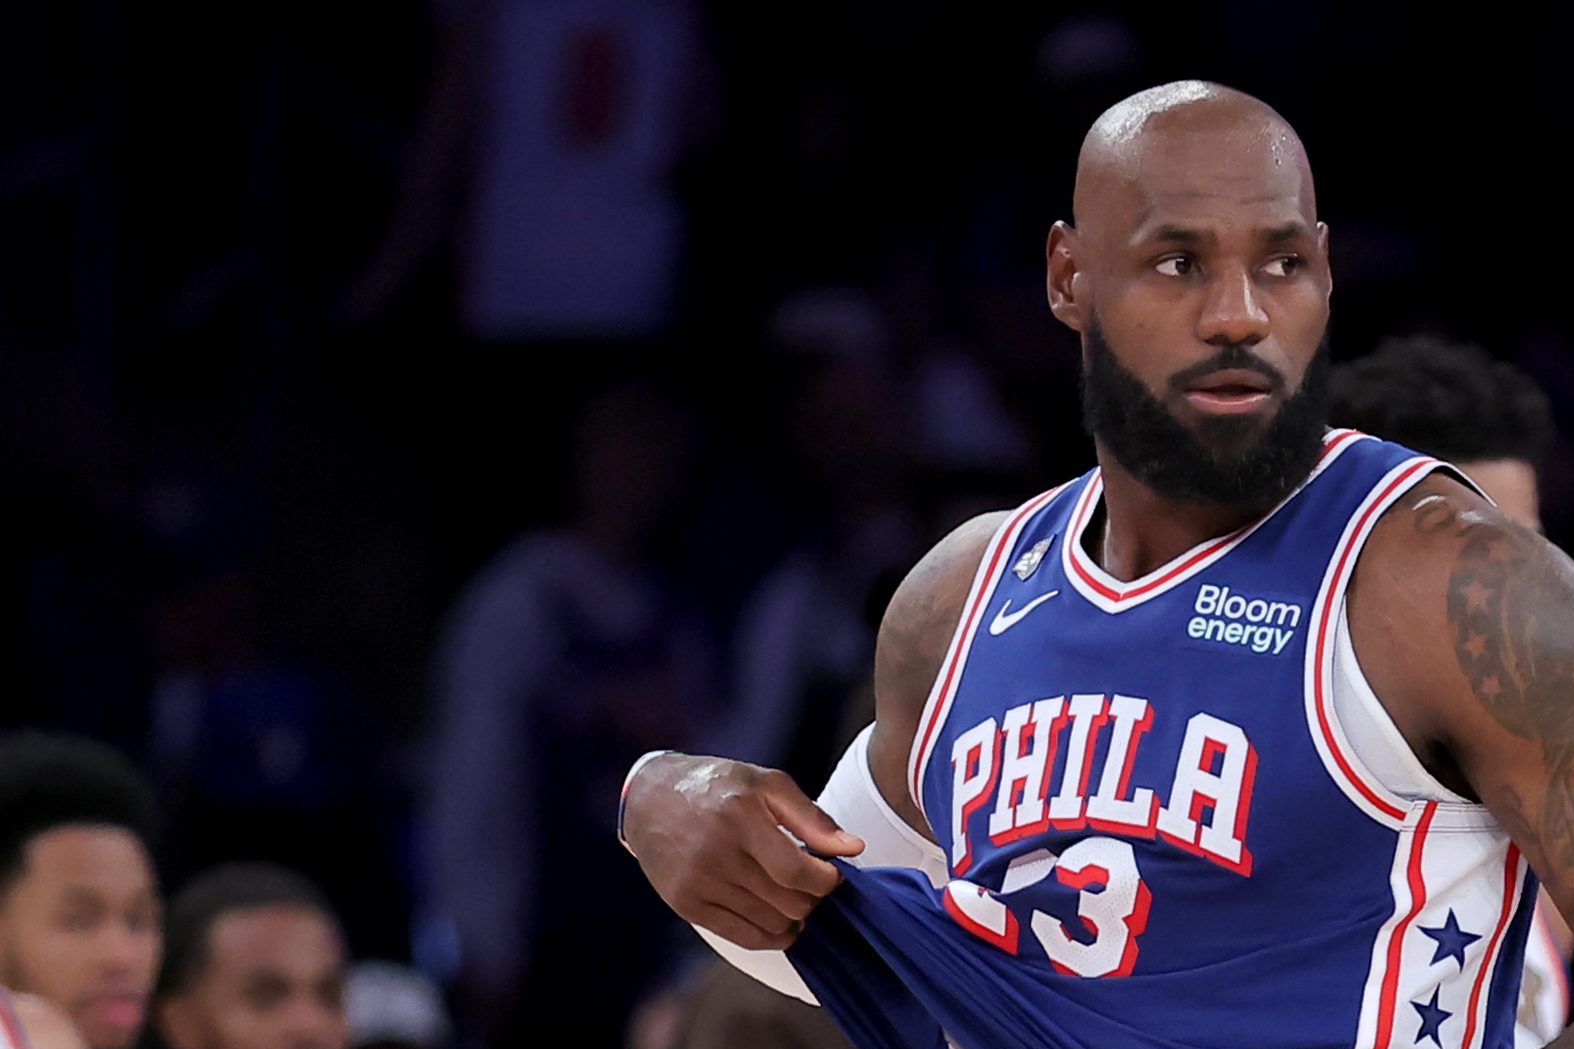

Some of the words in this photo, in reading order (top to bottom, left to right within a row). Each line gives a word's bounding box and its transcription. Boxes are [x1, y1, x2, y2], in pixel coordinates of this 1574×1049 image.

[1194, 584, 1302, 628] Bloom
[1187, 616, 1294, 655] energy
[951, 693, 1259, 878] PHILA
